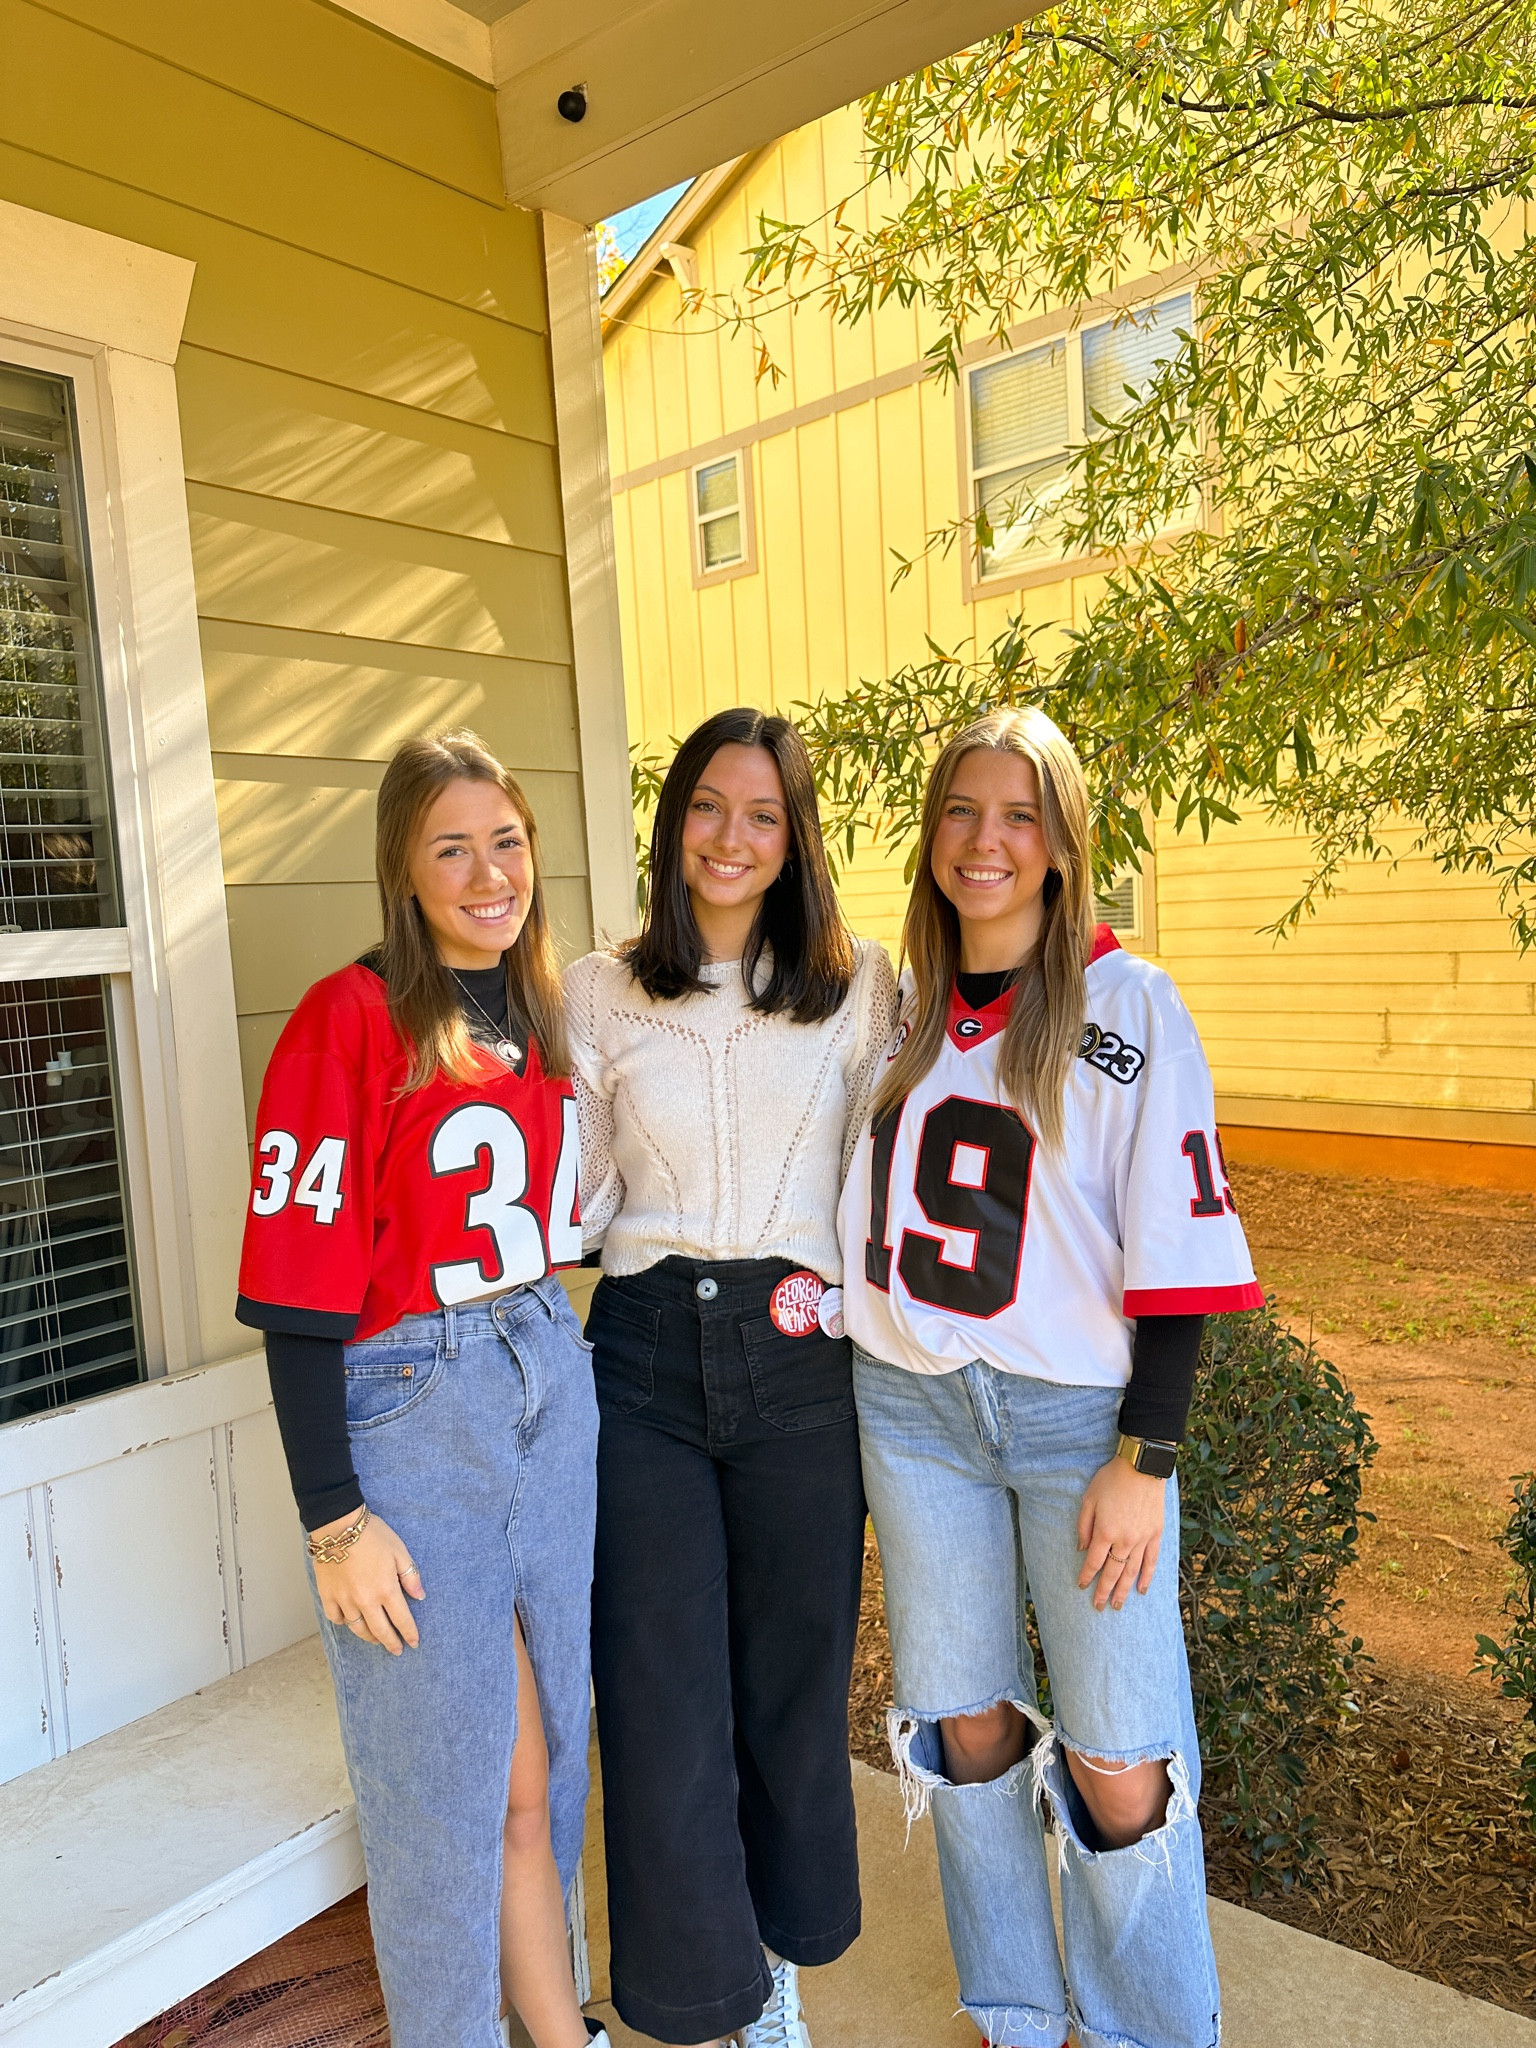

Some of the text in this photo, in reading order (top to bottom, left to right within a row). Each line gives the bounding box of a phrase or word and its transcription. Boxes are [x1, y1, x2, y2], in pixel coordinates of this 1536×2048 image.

[1088, 1033, 1144, 1083] 23
[252, 1128, 348, 1227] 34
[865, 1092, 1037, 1321] 19
[1180, 1129, 1237, 1217] 1
[775, 1276, 823, 1311] GEORGIA
